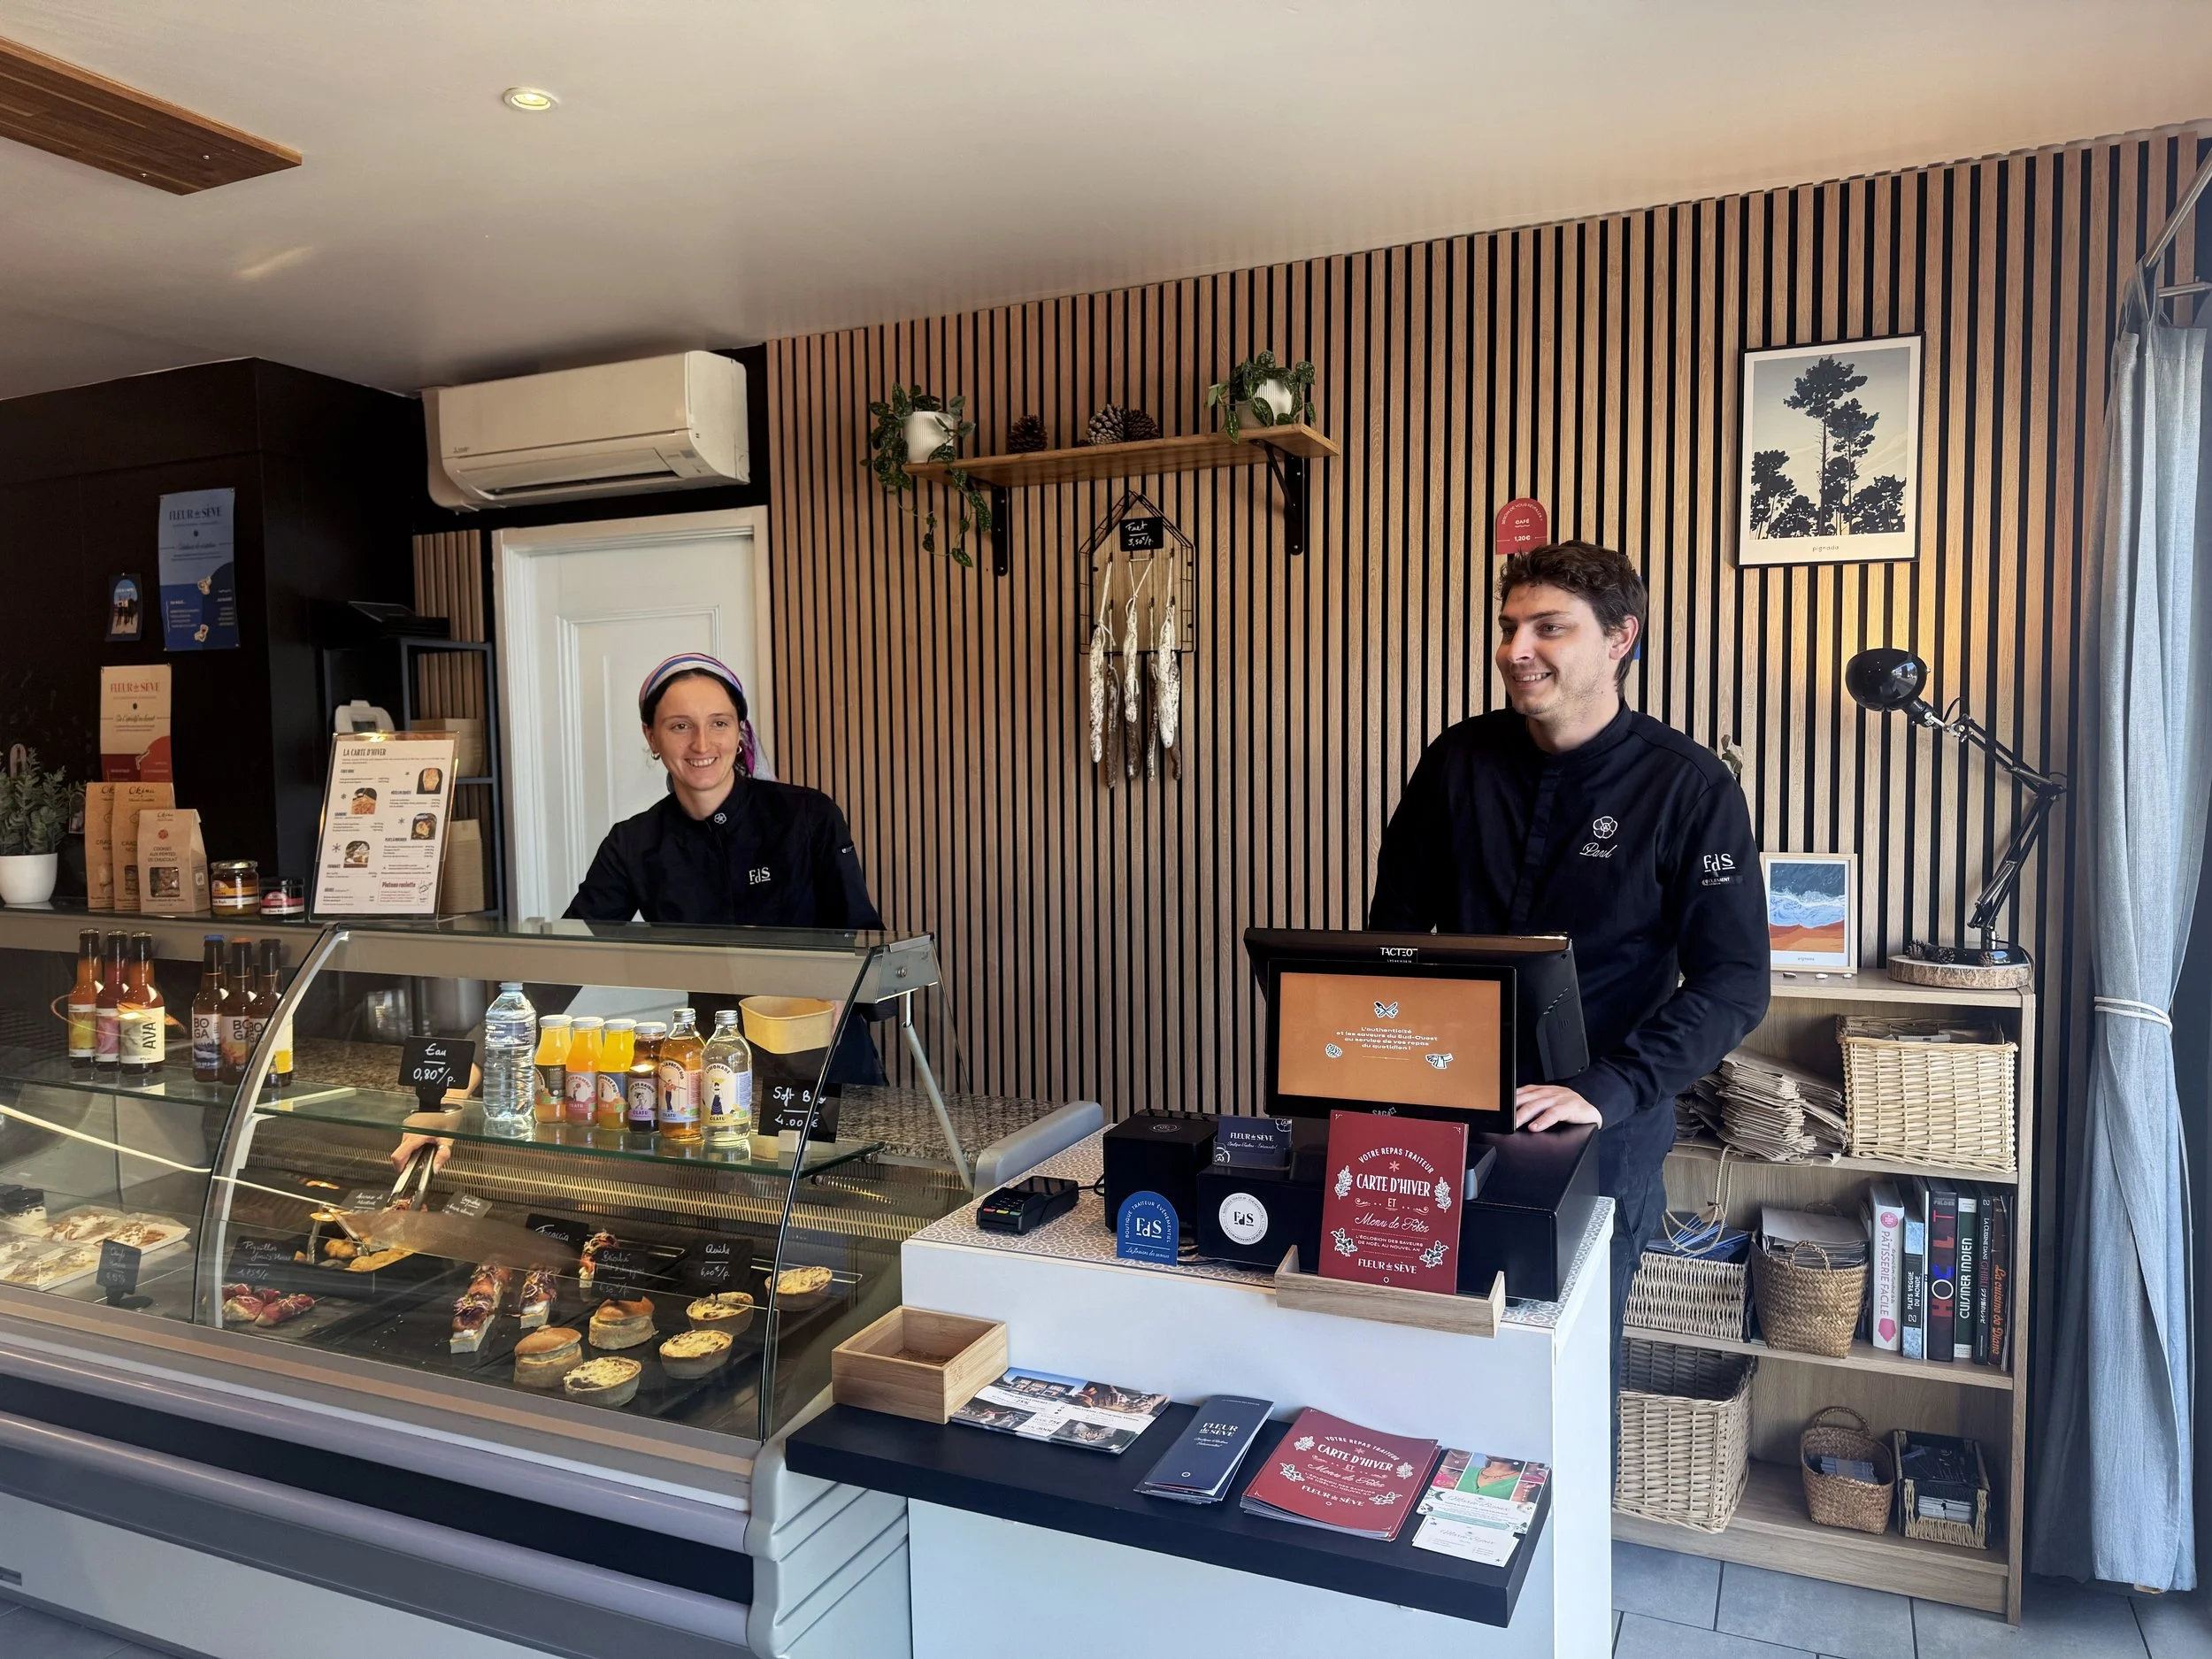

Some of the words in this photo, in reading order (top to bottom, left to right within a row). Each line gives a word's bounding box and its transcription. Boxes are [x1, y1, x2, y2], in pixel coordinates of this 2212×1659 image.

[169, 509, 193, 521] FLEUR
[111, 683, 132, 693] FLEUR
[141, 679, 160, 692] SÈVE
[1704, 853, 1736, 872] FdS
[749, 867, 771, 884] FdS
[194, 1018, 209, 1028] BO
[195, 1029, 209, 1039] GA
[425, 1043, 446, 1056] Eau
[706, 1064, 730, 1075] LIMONADE
[773, 1086, 795, 1106] Soft
[1256, 1133, 1274, 1142] SÈVE
[1358, 1149, 1380, 1164] VOTRE
[1381, 1147, 1402, 1156] REPAS
[1404, 1149, 1434, 1174] TRAITEUR
[1356, 1174, 1388, 1192] CARTE
[1390, 1177, 1430, 1197] D'HIVER
[1388, 1198, 1397, 1207] ET
[1132, 1200, 1154, 1210] TRAITEUR
[1156, 1204, 1171, 1243] ÉVÉNEMENTIEL
[1136, 1217, 1162, 1238] FdS
[1234, 1211, 1254, 1227] FdS
[1355, 1213, 1388, 1227] Menu
[1389, 1216, 1399, 1229] de
[1401, 1217, 1430, 1233] Fêtes
[1356, 1234, 1387, 1243] L'ÉCLOSION
[1881, 1231, 1892, 1282] PÂTISSERIE
[1962, 1238, 1972, 1273] INDIEN
[1358, 1258, 1385, 1270] FLEUR
[1386, 1262, 1393, 1271] de
[1394, 1261, 1417, 1275] SÈVE
[1994, 1264, 2006, 1281] La
[1880, 1283, 1890, 1316] FACILE
[1959, 1274, 1971, 1319] CUISINER
[1994, 1282, 2004, 1313] cuisine
[1993, 1314, 2003, 1325] de
[1993, 1327, 2002, 1355] Diane
[1203, 1422, 1238, 1432] FLEUR
[1317, 1444, 1351, 1462] CARTE
[1350, 1455, 1394, 1471] D'HIVER
[1349, 1440, 1371, 1448] REPAS
[1372, 1446, 1400, 1461] TRAITEUR
[1308, 1464, 1341, 1478] Menu
[1302, 1485, 1331, 1498] FLEUR
[1339, 1497, 1365, 1506] SÈVE
